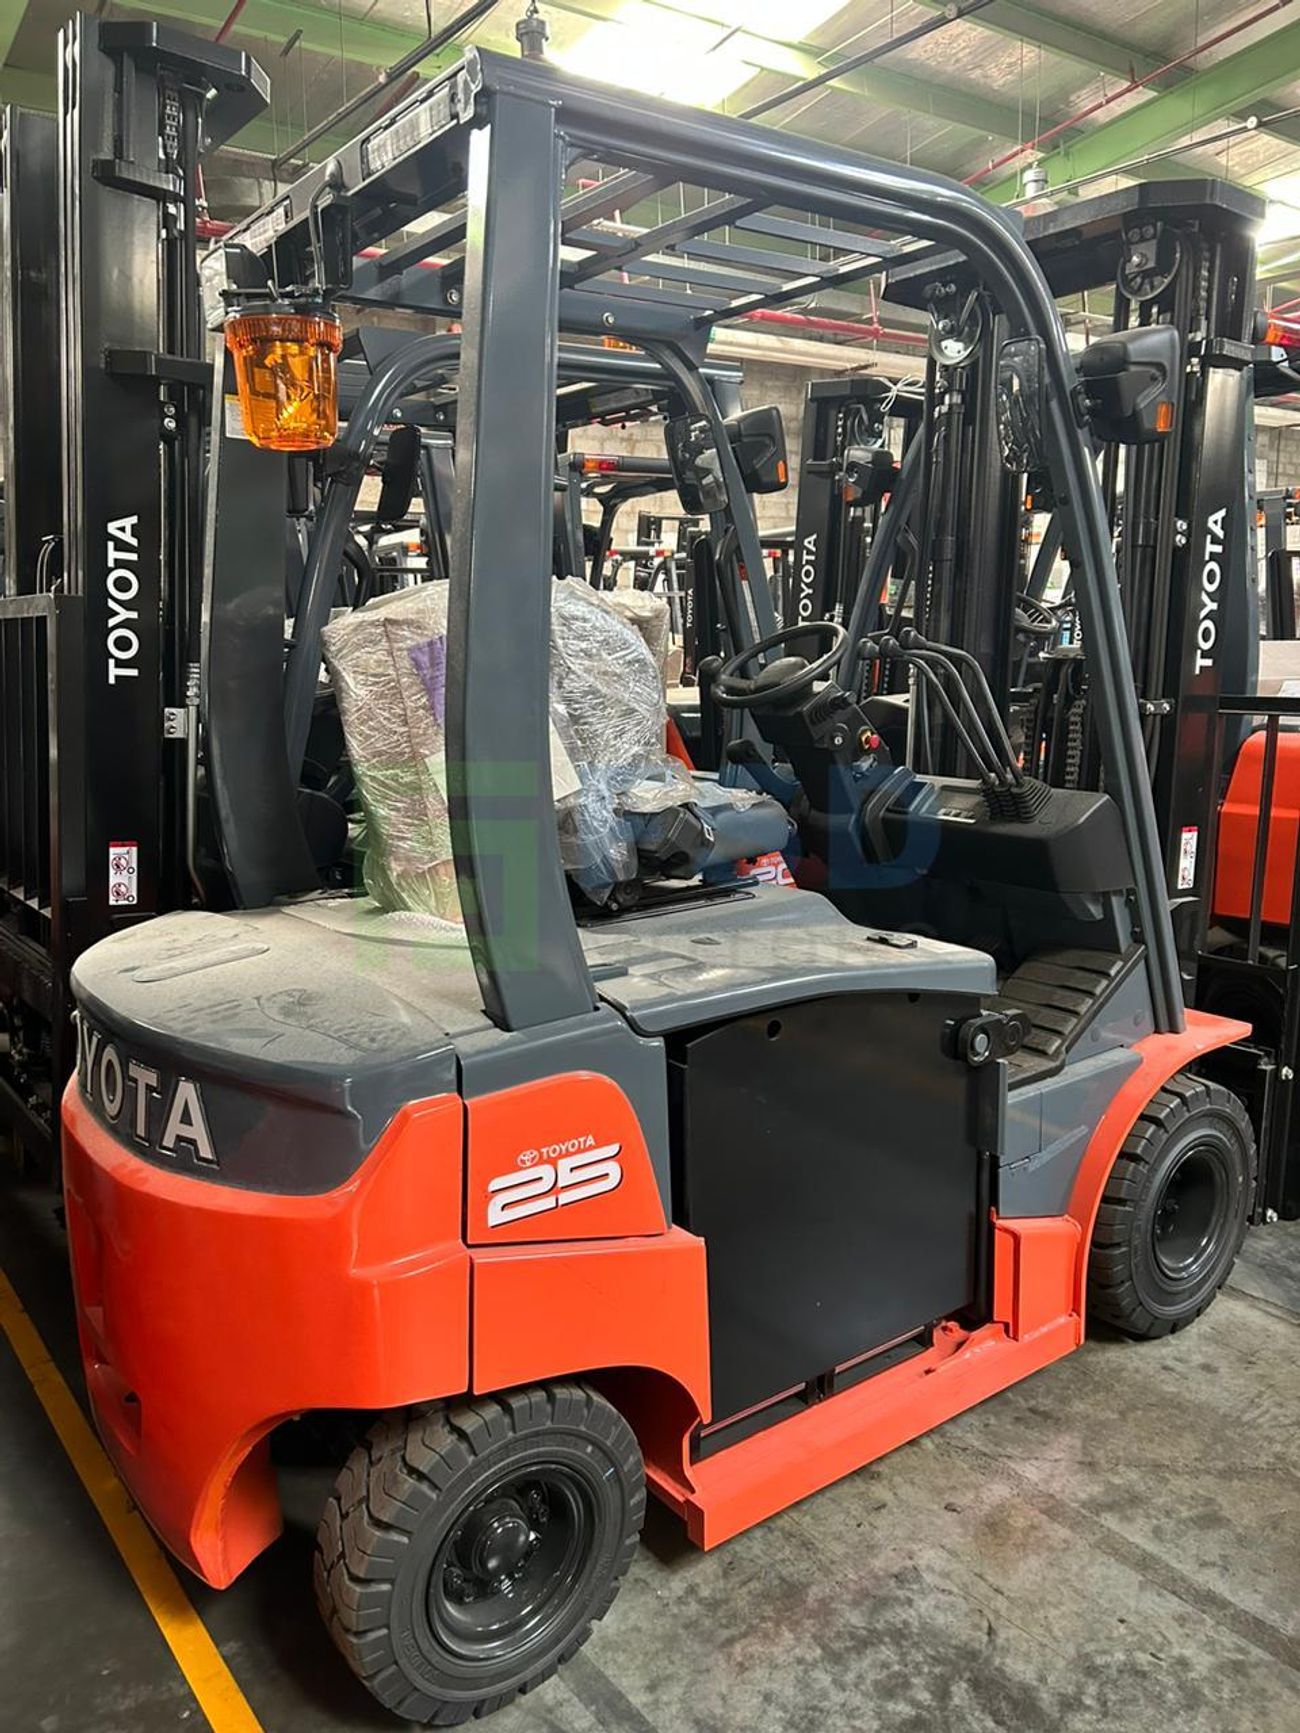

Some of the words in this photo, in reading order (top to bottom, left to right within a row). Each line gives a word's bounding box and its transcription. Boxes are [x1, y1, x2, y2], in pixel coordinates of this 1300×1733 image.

[106, 514, 140, 685] TOYOTA
[798, 532, 818, 627] TOYOTA
[1195, 507, 1227, 675] TOYOTA
[71, 1010, 220, 1170] YOTA
[540, 1134, 596, 1161] TOYOTA
[487, 1143, 624, 1229] 25
